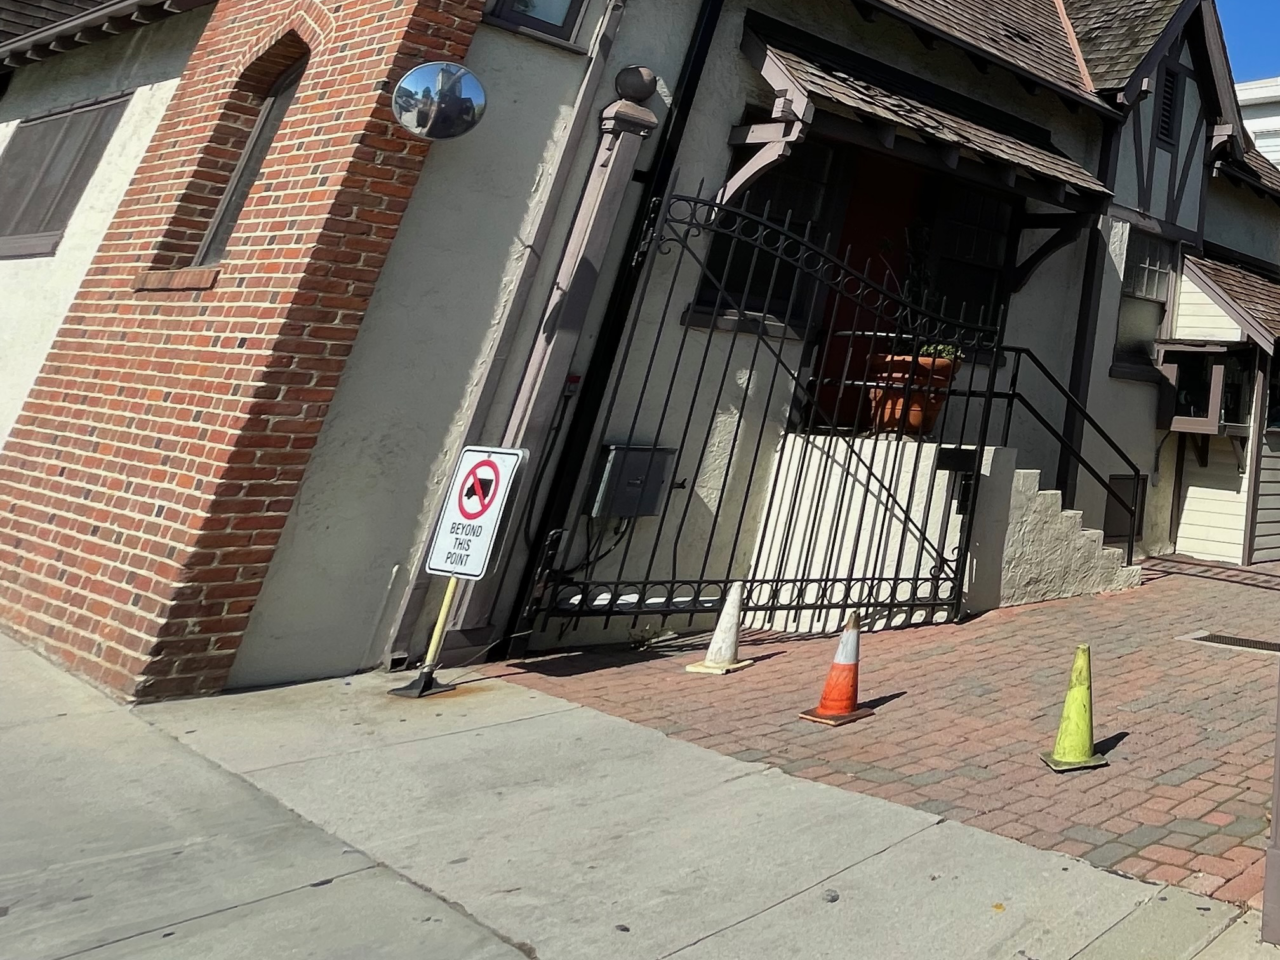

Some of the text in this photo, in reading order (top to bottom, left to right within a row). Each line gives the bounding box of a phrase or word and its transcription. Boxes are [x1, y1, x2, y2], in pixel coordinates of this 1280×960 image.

[450, 522, 482, 537] BEYOND
[453, 538, 471, 551] THIS
[445, 552, 470, 566] POINT
